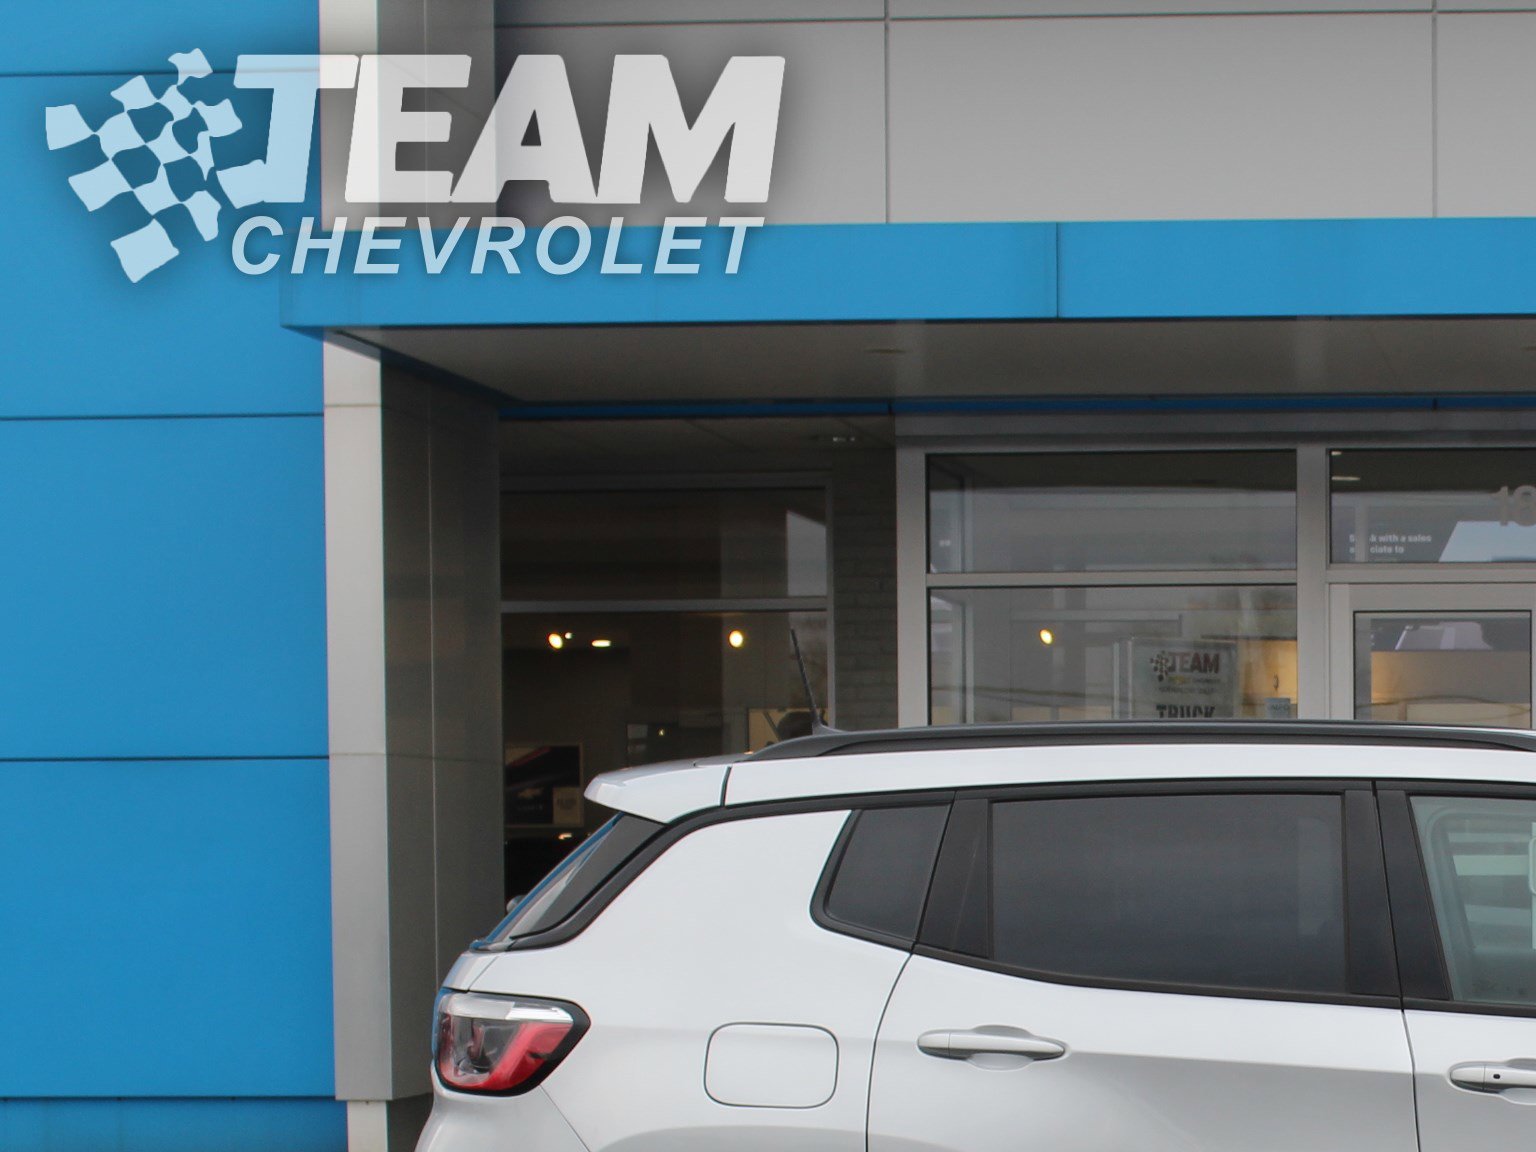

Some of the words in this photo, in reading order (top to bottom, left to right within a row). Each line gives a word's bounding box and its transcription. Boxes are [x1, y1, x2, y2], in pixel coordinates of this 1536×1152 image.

[1378, 534, 1399, 543] with
[1408, 534, 1433, 543] sales
[1168, 652, 1220, 674] TEAM
